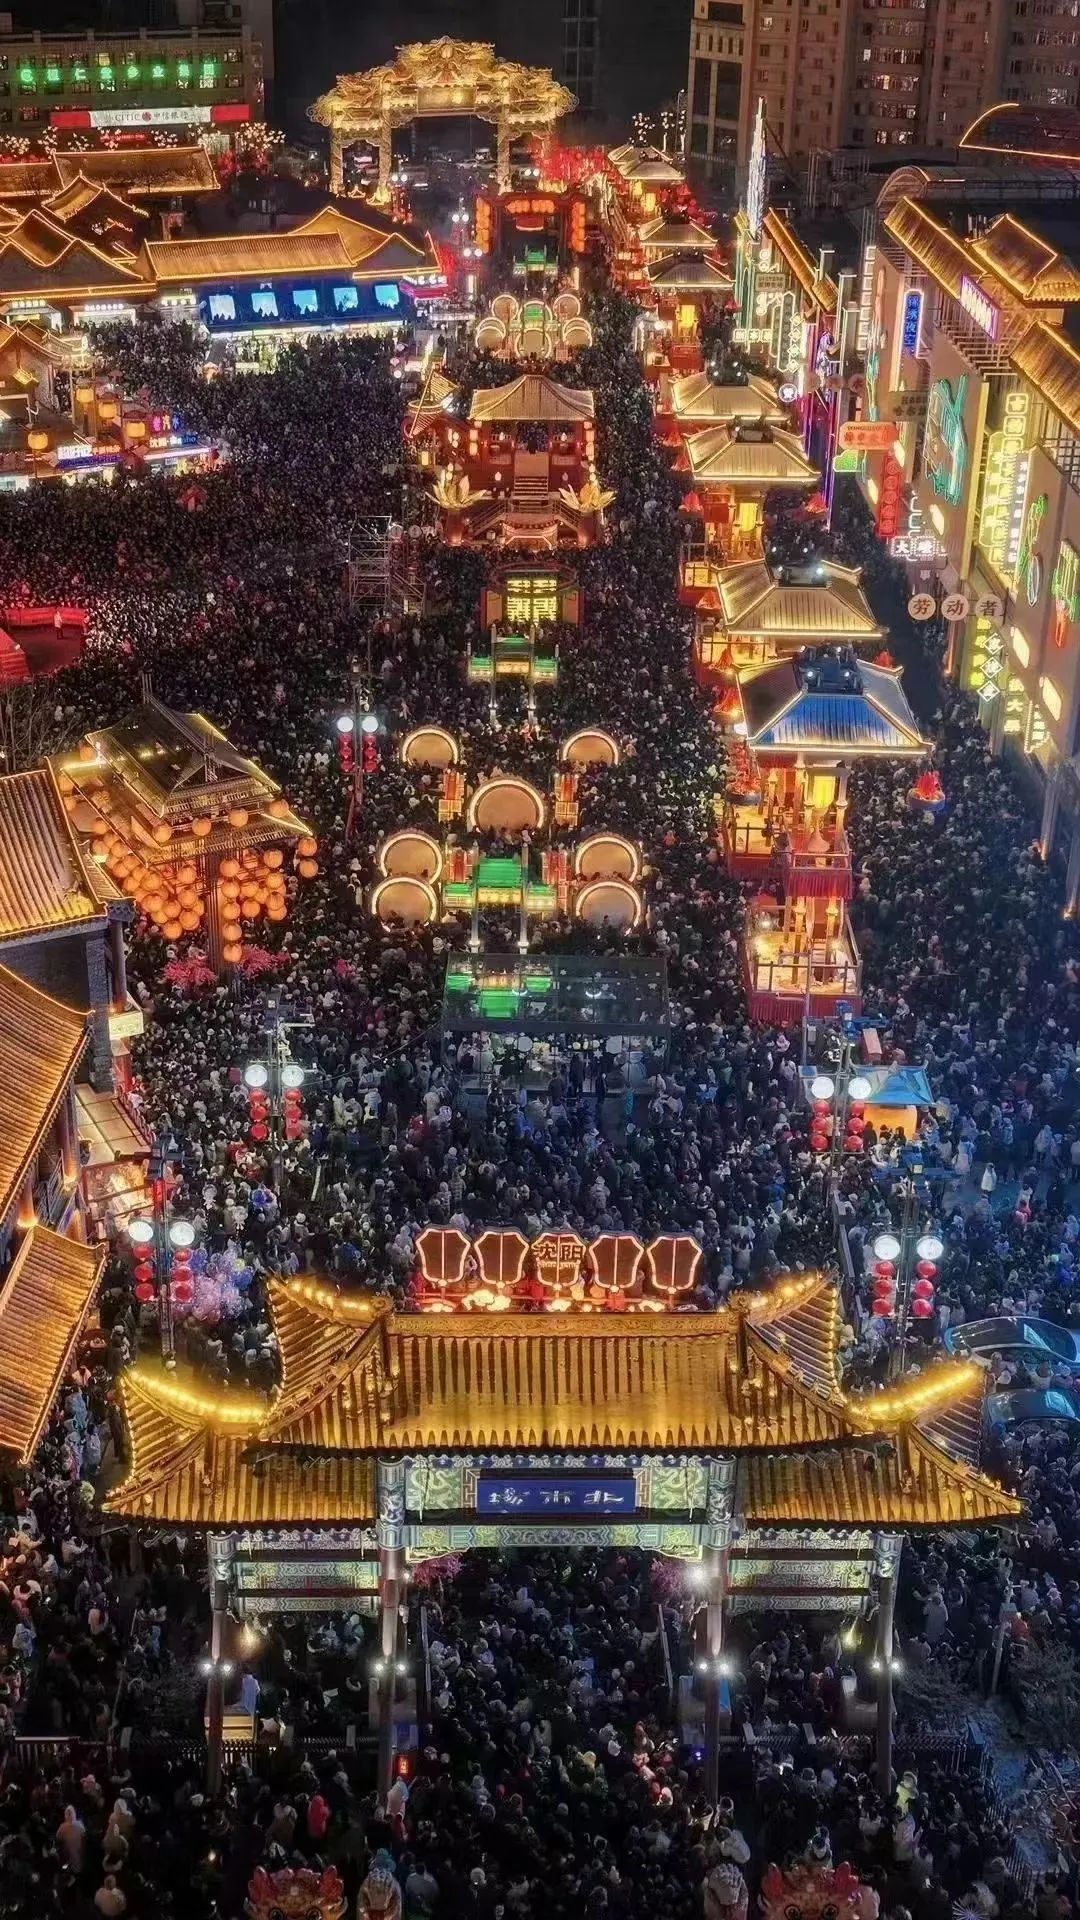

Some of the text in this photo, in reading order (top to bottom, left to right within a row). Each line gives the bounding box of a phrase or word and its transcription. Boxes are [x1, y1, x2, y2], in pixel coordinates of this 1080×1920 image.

[115, 112, 141, 122] CITIC
[154, 111, 189, 122] 中信银行
[531, 1241, 584, 1260] 沈阳
